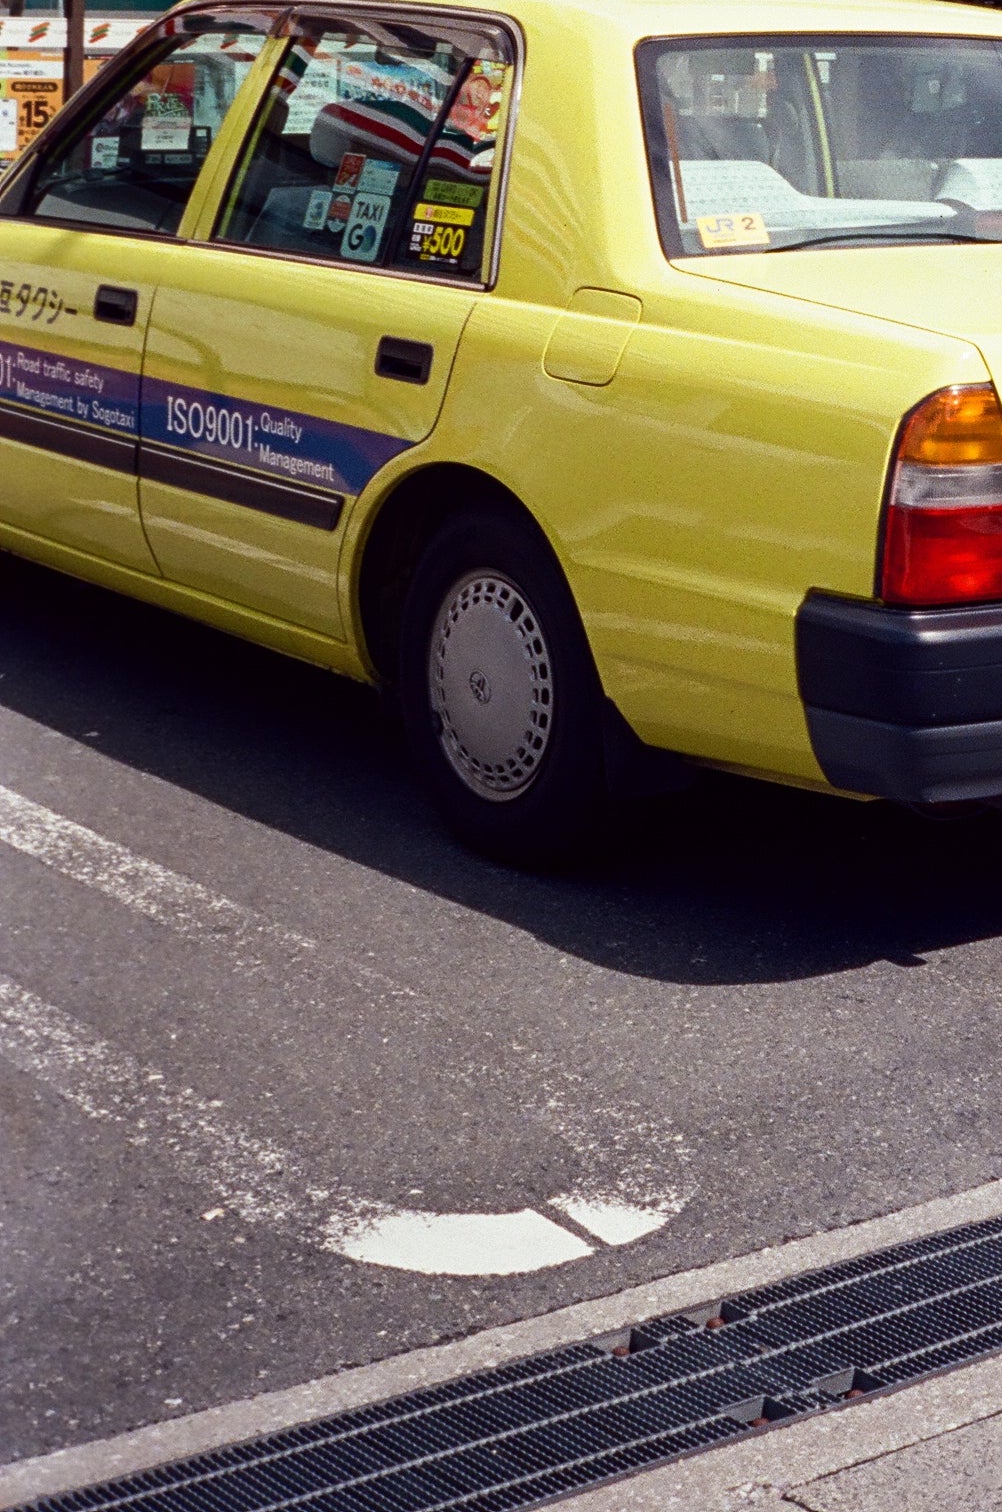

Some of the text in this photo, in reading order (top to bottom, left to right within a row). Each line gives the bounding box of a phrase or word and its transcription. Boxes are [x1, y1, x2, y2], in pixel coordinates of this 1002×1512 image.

[356, 200, 385, 224] TAXI
[705, 217, 756, 233] JR 2
[17, 352, 104, 393] Road traffic safety
[17, 381, 135, 429] Management by Sogotaxi
[260, 412, 302, 444] Quality
[259, 443, 334, 481] Management
